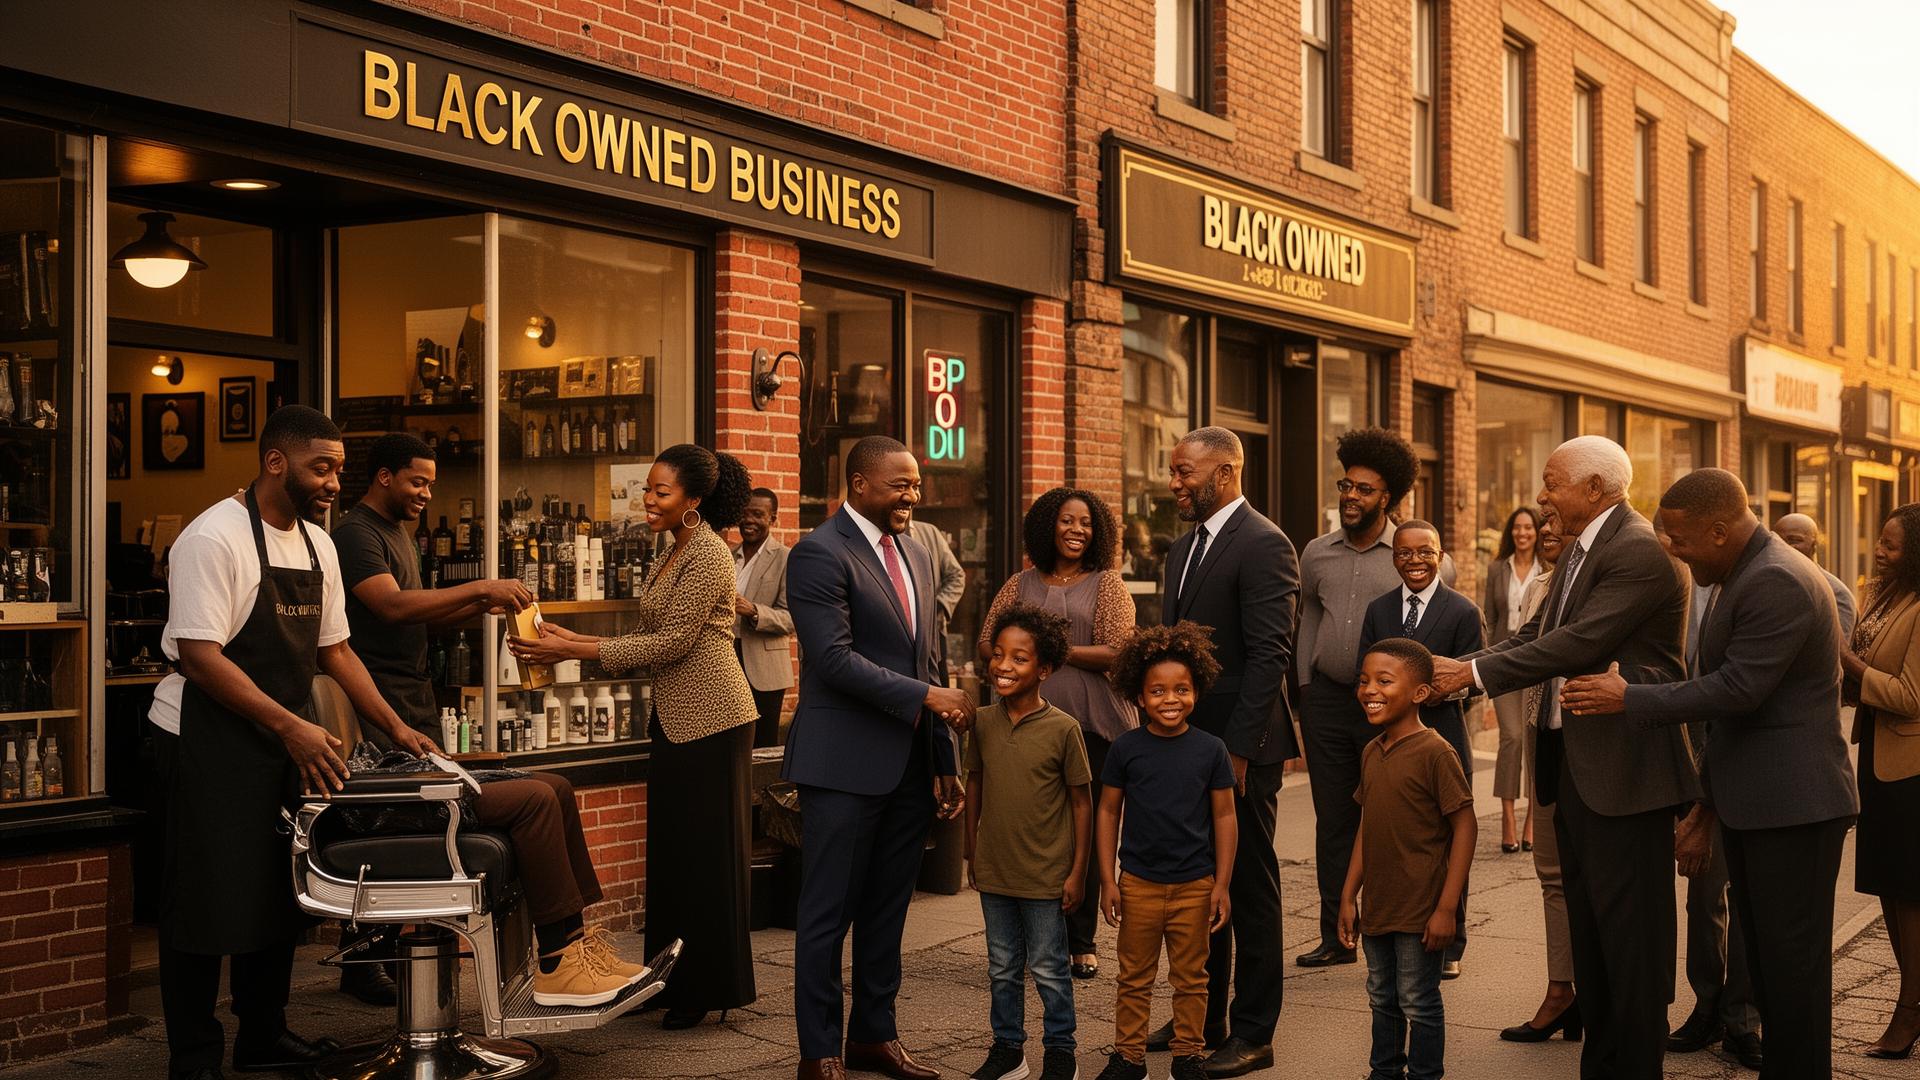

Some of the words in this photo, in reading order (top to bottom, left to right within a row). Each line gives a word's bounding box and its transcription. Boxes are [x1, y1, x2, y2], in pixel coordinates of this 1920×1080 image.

[363, 50, 544, 156] BLACK
[555, 102, 717, 194] OWNED
[729, 146, 901, 239] BUSINESS
[1204, 194, 1283, 267] BLACK
[1285, 220, 1366, 286] OWNED
[927, 356, 966, 393] BP
[935, 392, 957, 429] O
